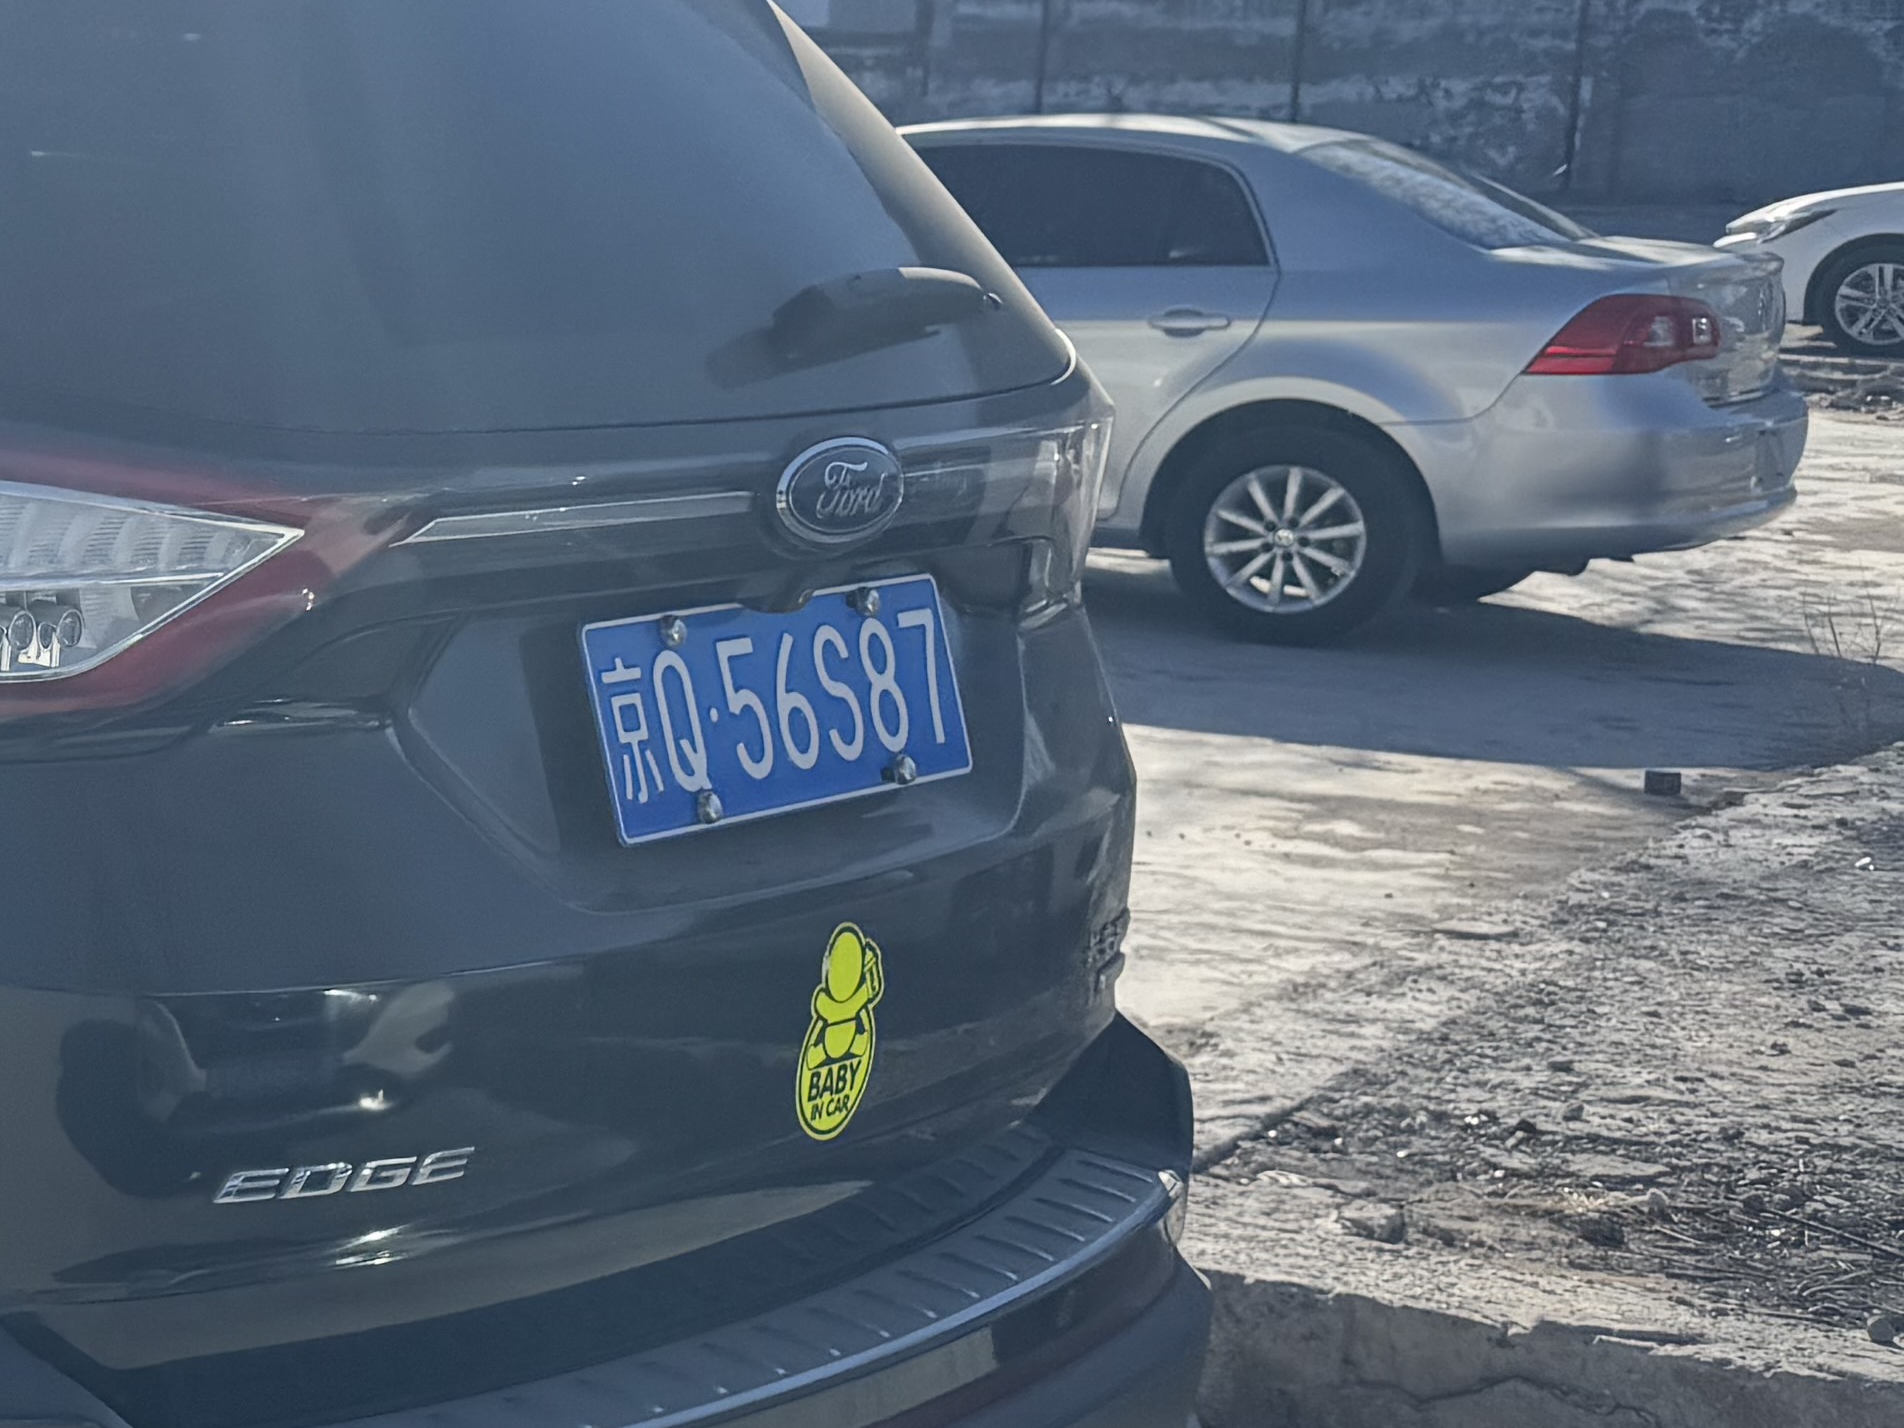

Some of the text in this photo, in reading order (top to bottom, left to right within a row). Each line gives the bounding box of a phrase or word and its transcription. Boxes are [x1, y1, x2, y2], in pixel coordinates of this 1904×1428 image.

[816, 461, 889, 519] Ford
[808, 1060, 862, 1101] BABY
[811, 1095, 850, 1120] IN CAR
[213, 1146, 475, 1204] EDGE
